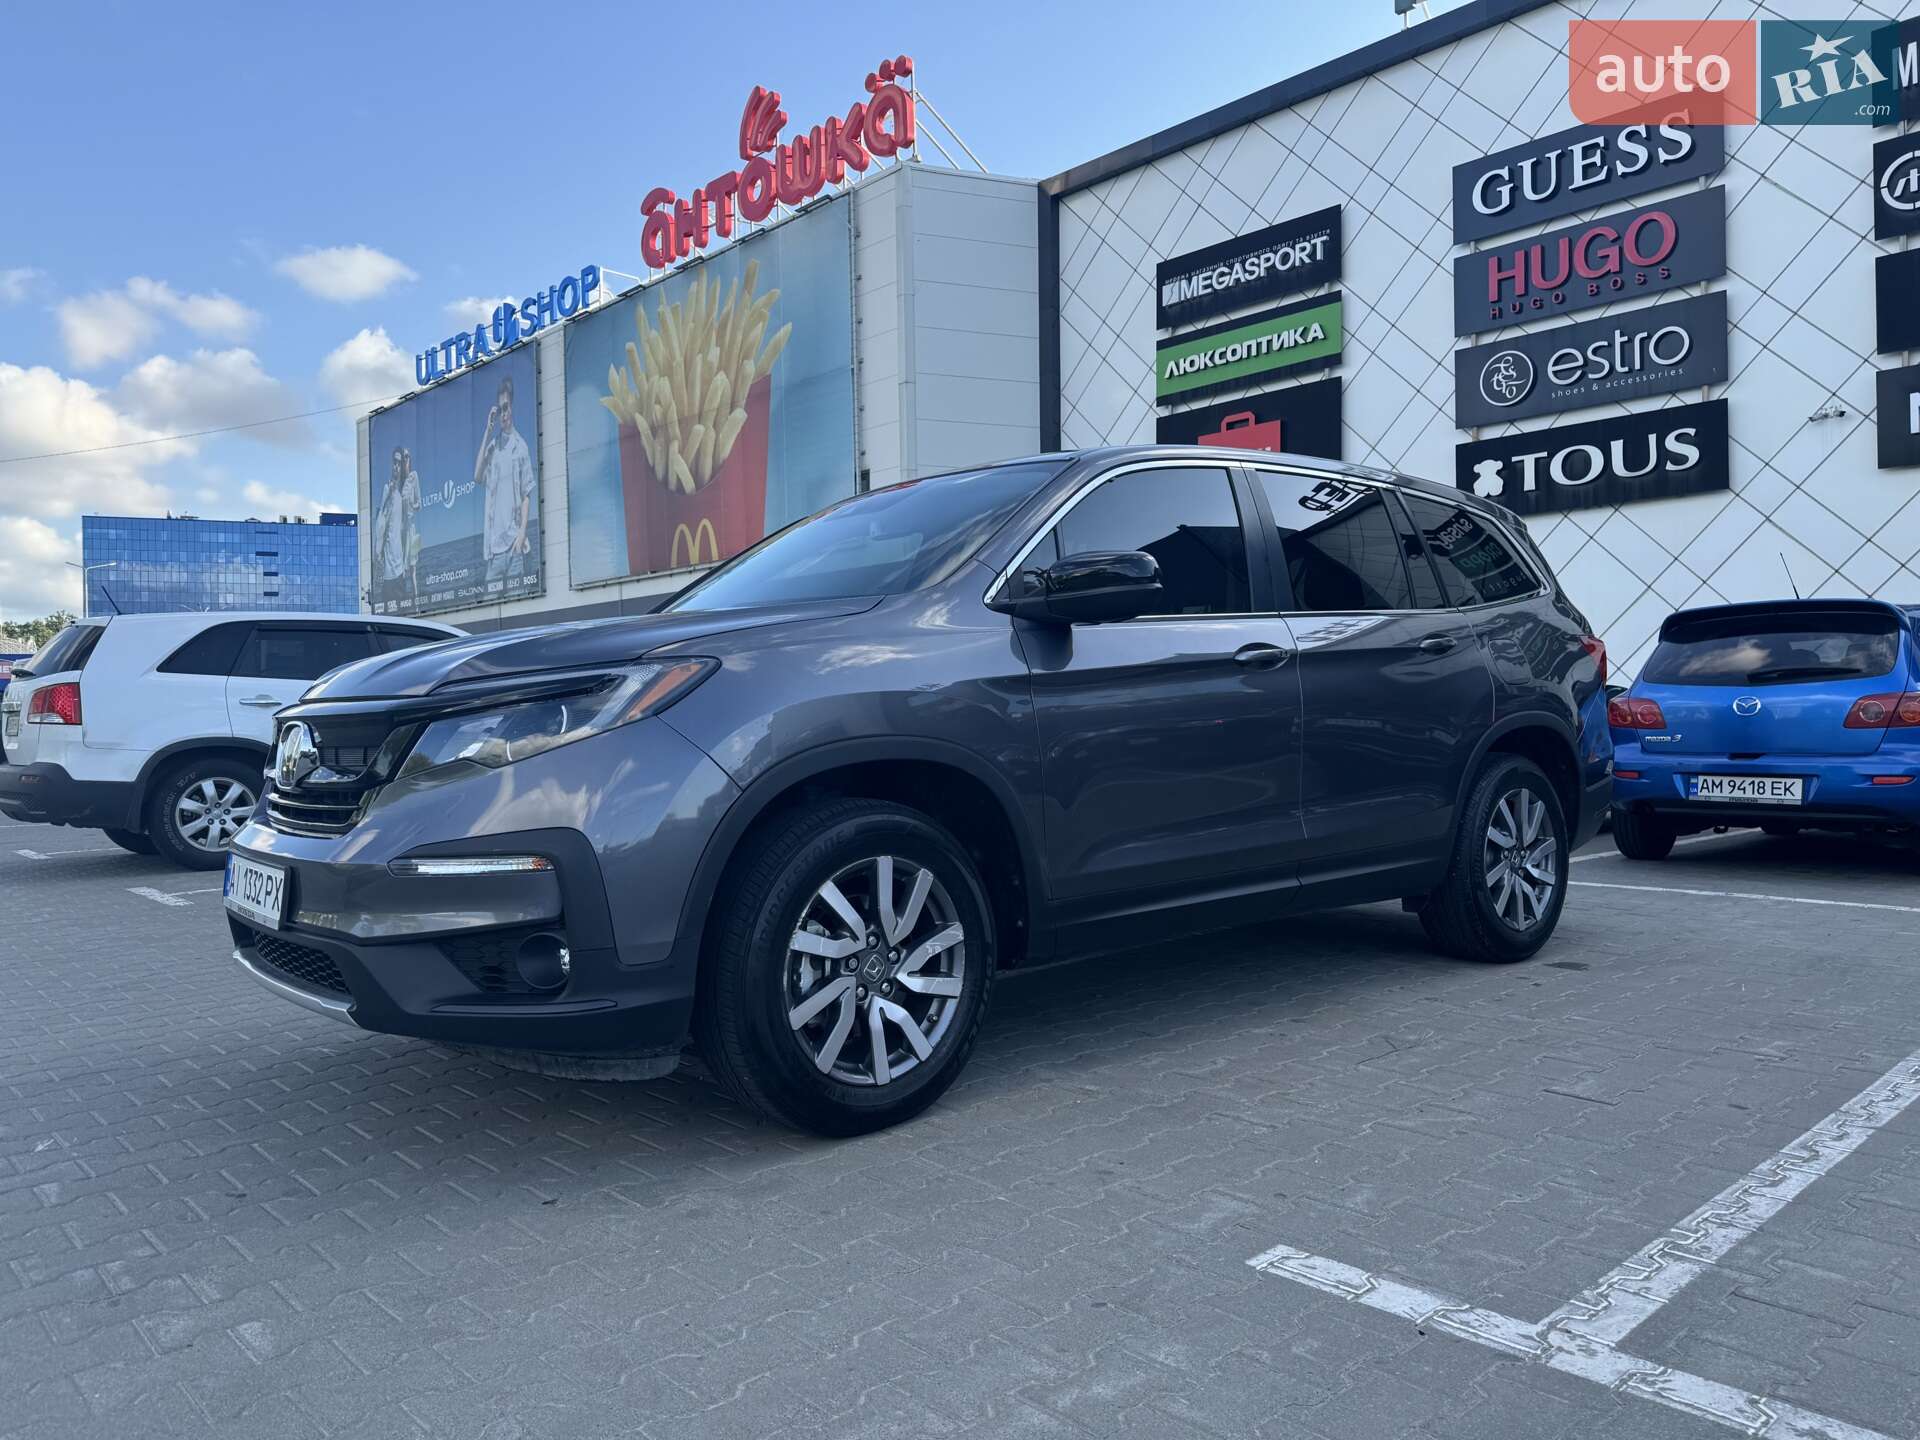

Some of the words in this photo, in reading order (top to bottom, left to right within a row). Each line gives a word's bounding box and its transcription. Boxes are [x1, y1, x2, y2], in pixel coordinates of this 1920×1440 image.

[1472, 108, 1695, 215] GUESS
[1180, 235, 1330, 301] MEGASPORT
[1488, 211, 1678, 302] HUGO
[1489, 292, 1564, 320] HUGO
[1588, 266, 1671, 296] BOSS
[416, 323, 494, 386] ULTRA
[521, 264, 600, 337] SHOP
[1164, 322, 1325, 379] ЛЮКСОПТИКА
[1547, 326, 1691, 385] estro
[1551, 385, 1585, 399] shoes
[1592, 382, 1600, 392] &
[1606, 367, 1684, 389] accessories
[1511, 427, 1701, 492] TOUS
[456, 481, 476, 497] SHOP
[426, 567, 469, 585] ultra-shop.com
[523, 574, 537, 585] BOSS
[1699, 778, 1723, 795] AM
[1727, 779, 1766, 796] 9418
[1770, 781, 1796, 797] EK
[244, 867, 264, 906] 1332
[264, 874, 283, 912] PX
